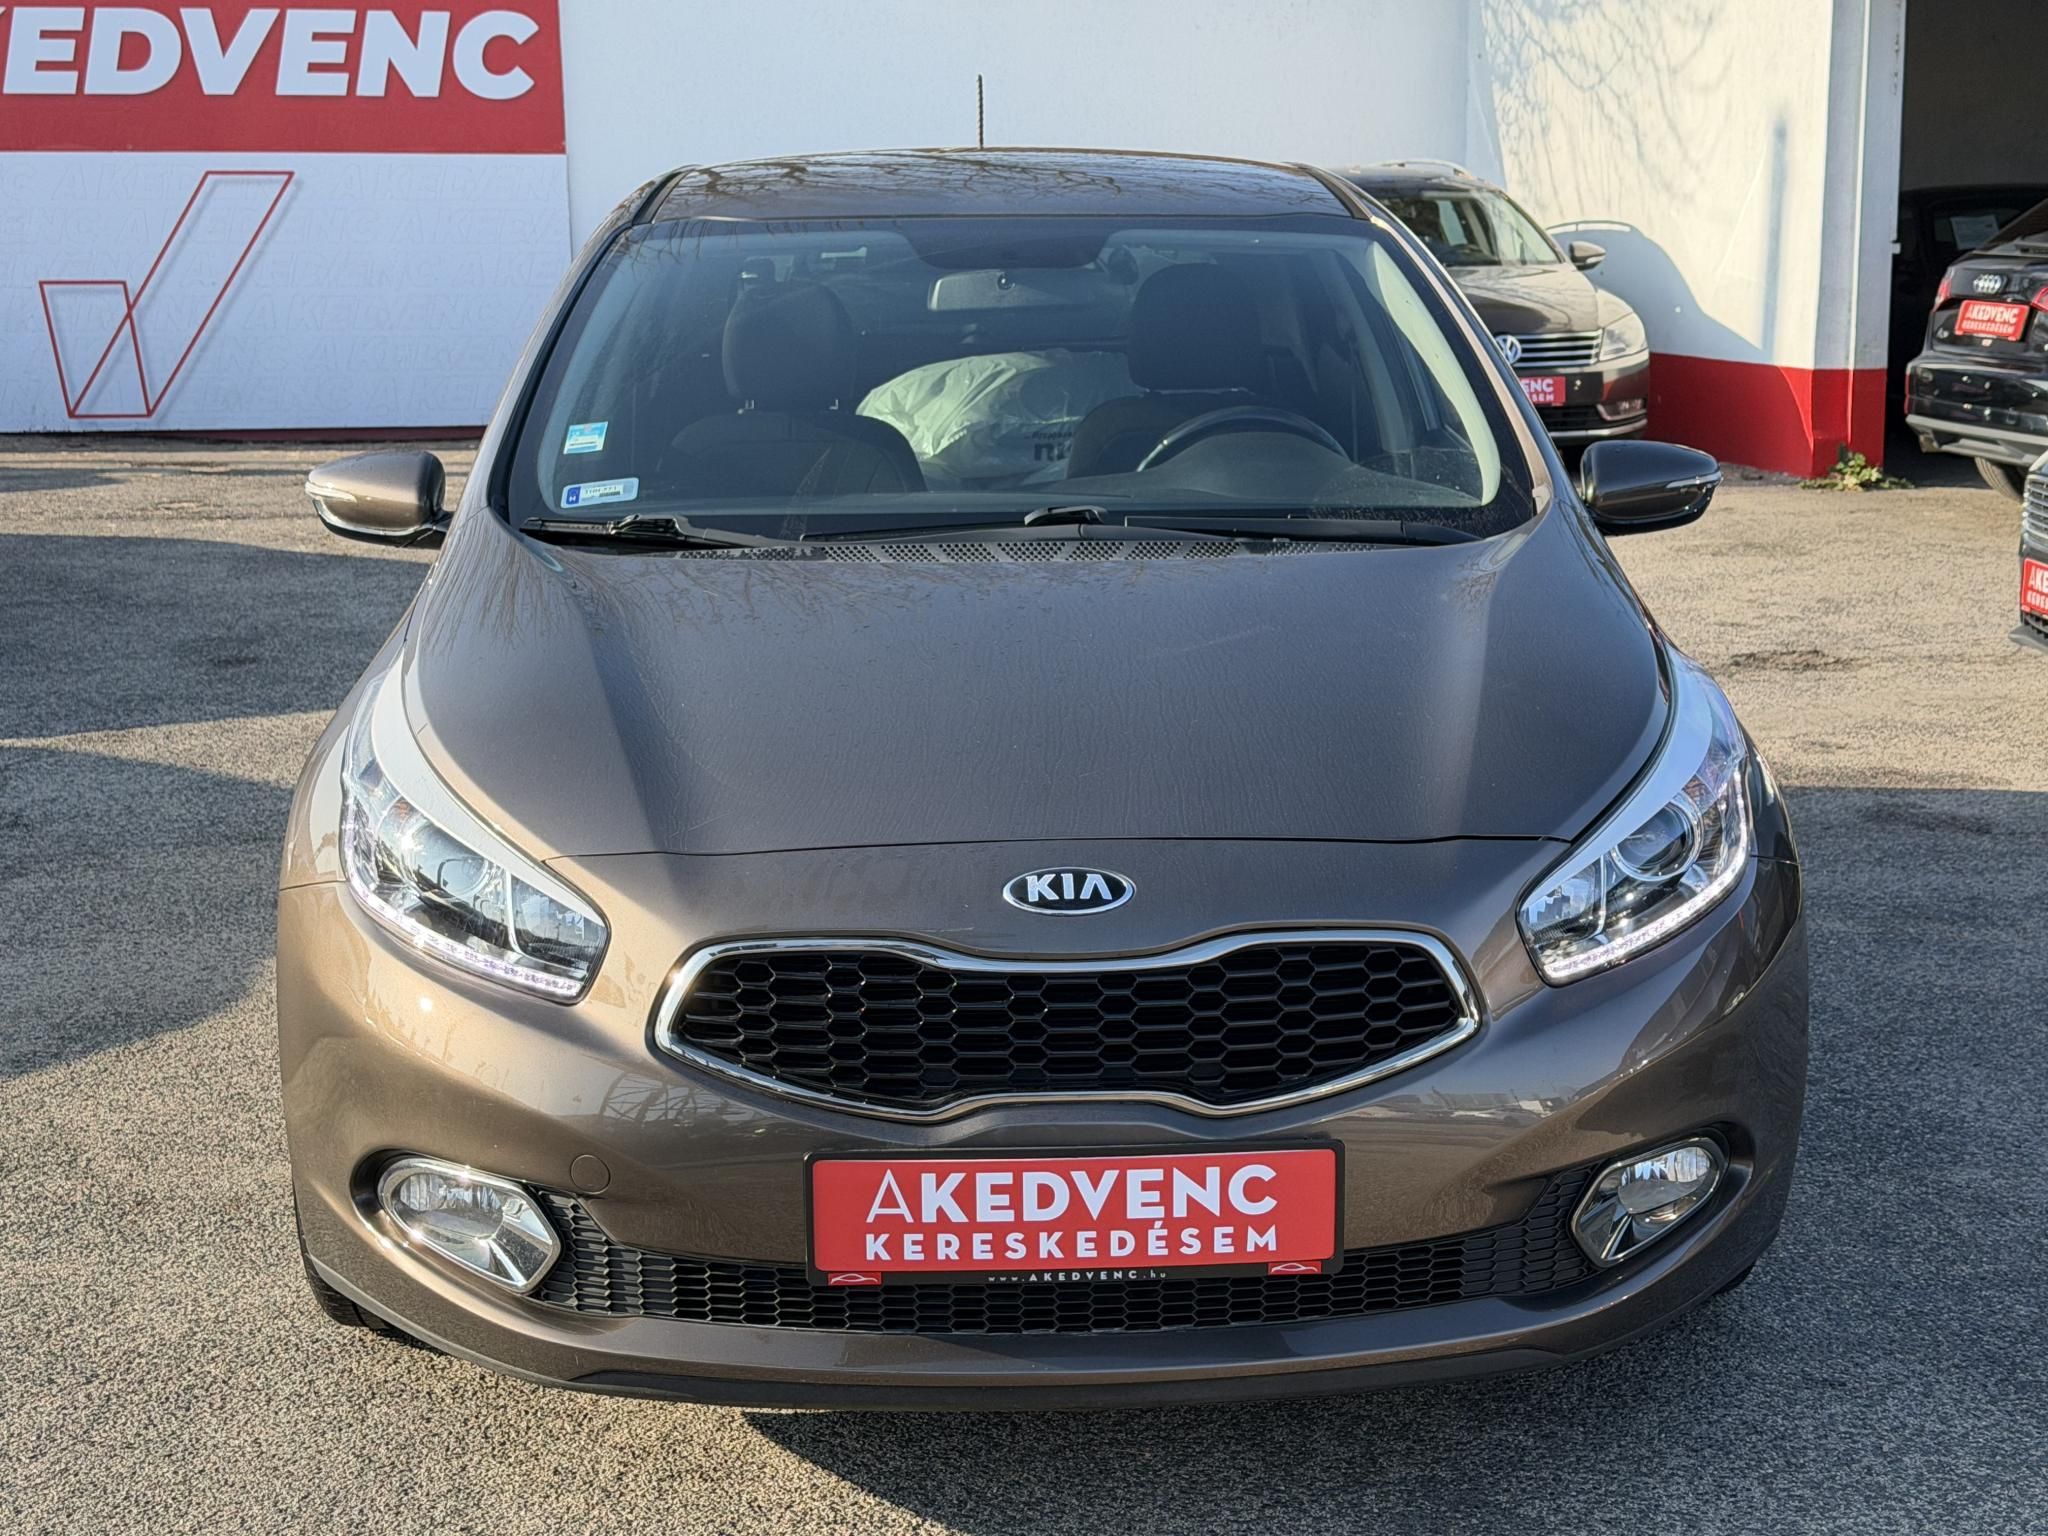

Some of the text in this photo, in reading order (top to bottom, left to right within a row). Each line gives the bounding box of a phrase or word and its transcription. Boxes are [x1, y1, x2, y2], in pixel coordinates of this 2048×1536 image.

[0, 6, 540, 101] EDVENC
[1026, 873, 1113, 903] KIA
[866, 1164, 1278, 1224] AKEDVENC
[866, 1220, 1278, 1261] KERESKEDÉSEM
[988, 1270, 1167, 1282] www.AKEDVENC.hu
